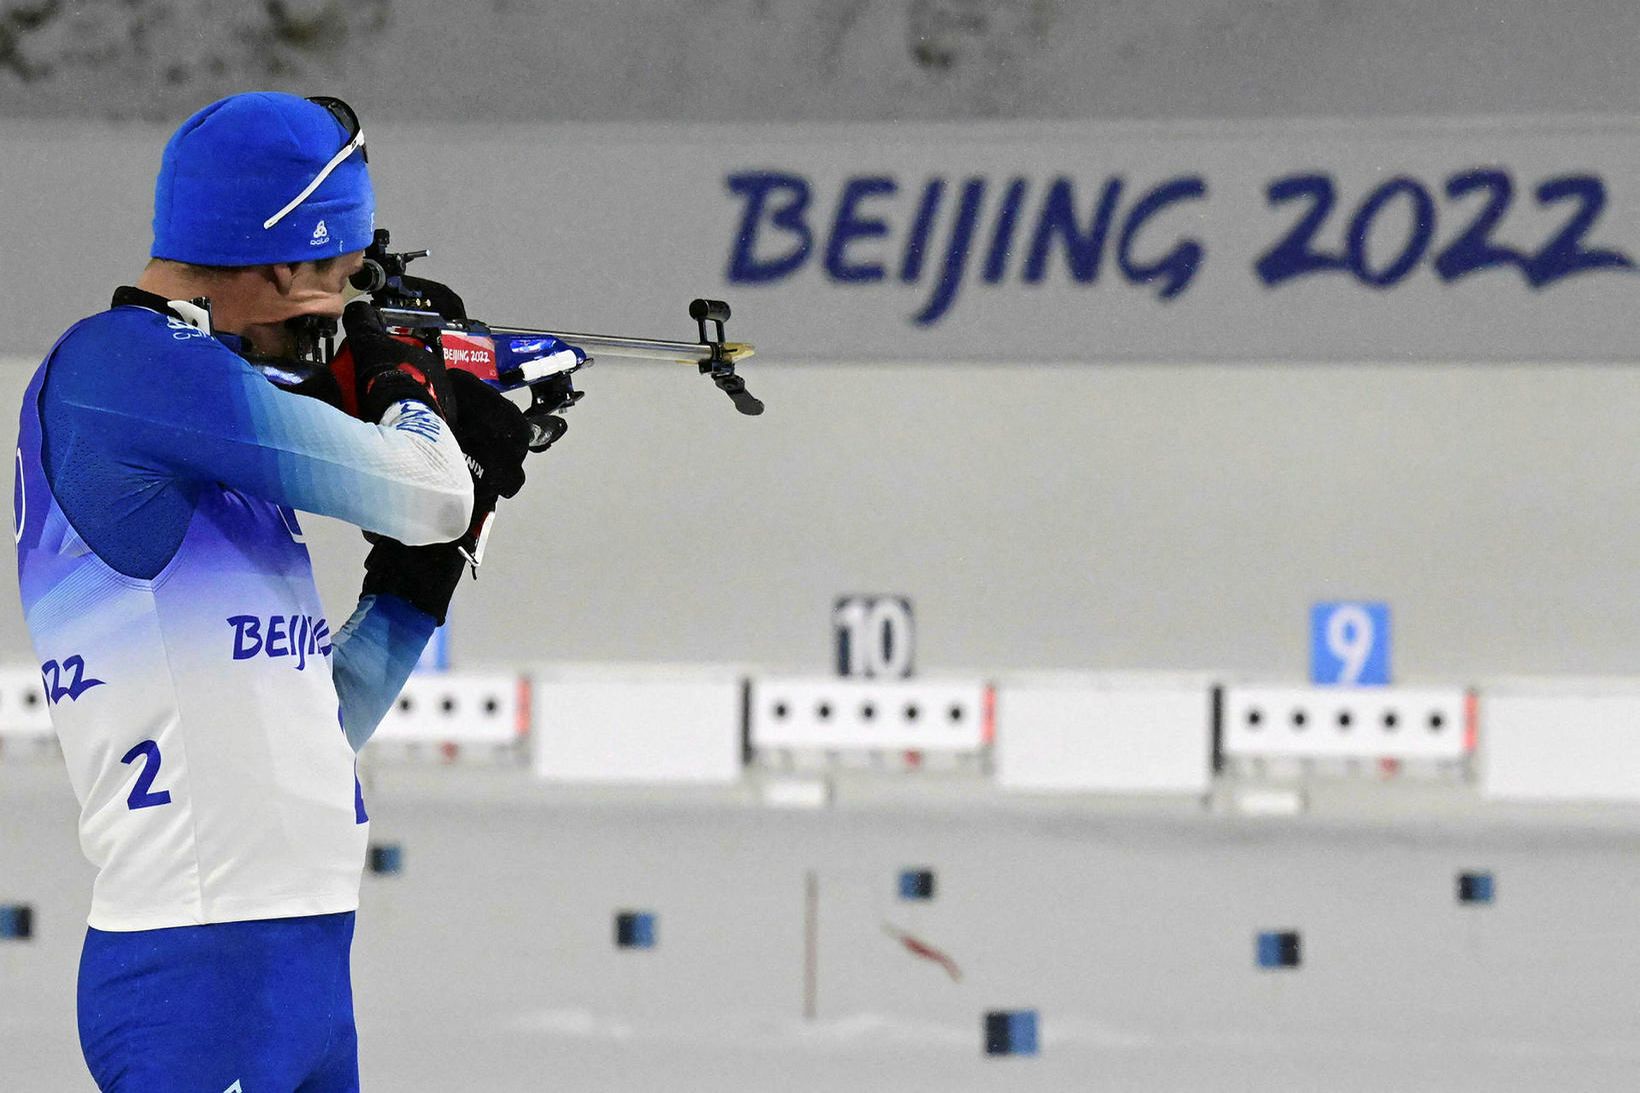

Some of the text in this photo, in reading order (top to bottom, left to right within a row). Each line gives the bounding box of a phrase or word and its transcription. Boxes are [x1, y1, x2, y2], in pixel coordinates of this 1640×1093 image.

[726, 168, 1638, 325] BEIJING 2022
[443, 348, 491, 364] BEIJING 2022
[837, 598, 912, 681] 10
[1327, 604, 1374, 686] 9
[120, 739, 172, 811] 2
